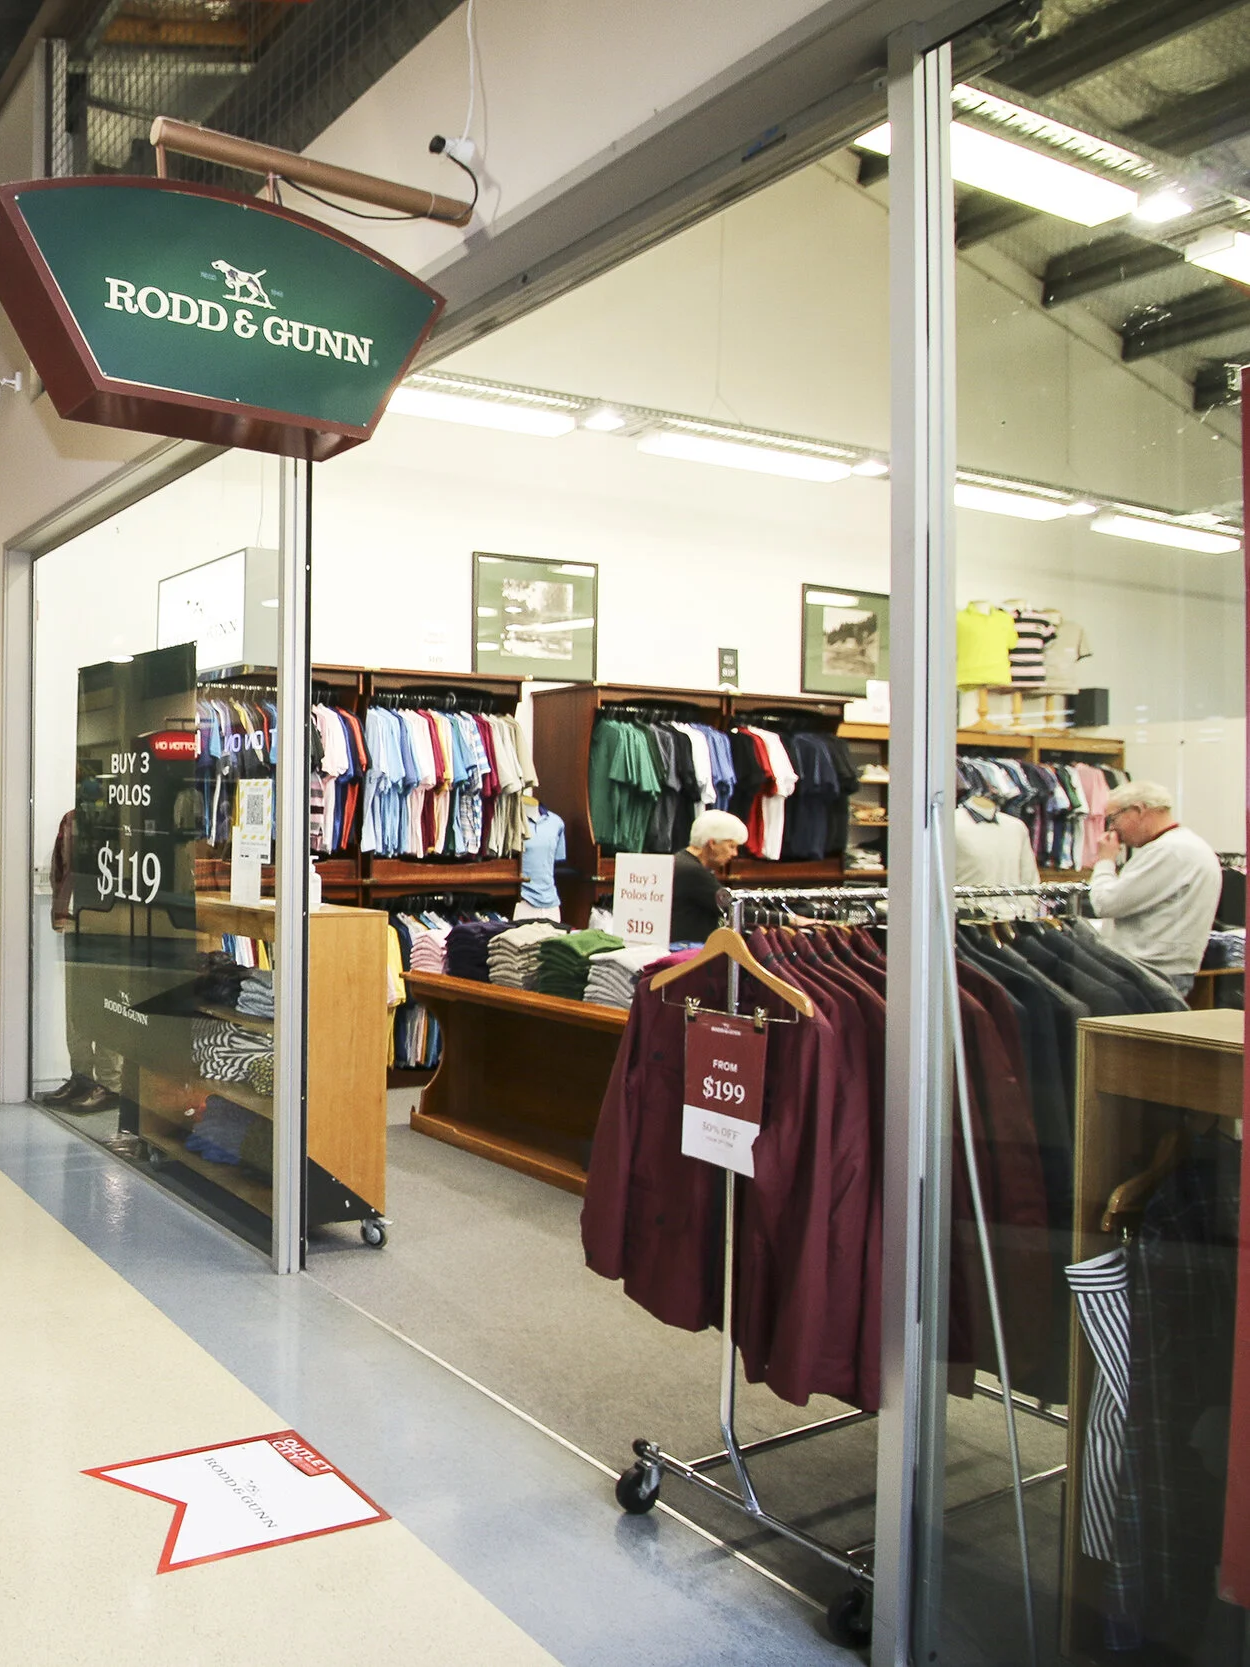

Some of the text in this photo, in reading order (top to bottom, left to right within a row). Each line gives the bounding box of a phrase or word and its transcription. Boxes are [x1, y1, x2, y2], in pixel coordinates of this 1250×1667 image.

[104, 276, 374, 366] RODD & GUNN
[111, 751, 150, 774] BUY 3
[108, 784, 151, 806] POLOS
[97, 840, 162, 904] $119
[629, 873, 657, 887] Buy 3
[621, 889, 664, 902] Polos for
[626, 919, 654, 935] $119
[103, 998, 122, 1014] RODD
[712, 1059, 738, 1073] FROM
[702, 1076, 745, 1105] $199
[272, 1440, 303, 1460] CITY
[284, 1438, 334, 1471] OUTLET
[204, 1457, 237, 1487] RODD
[241, 1495, 278, 1528] GUNN
